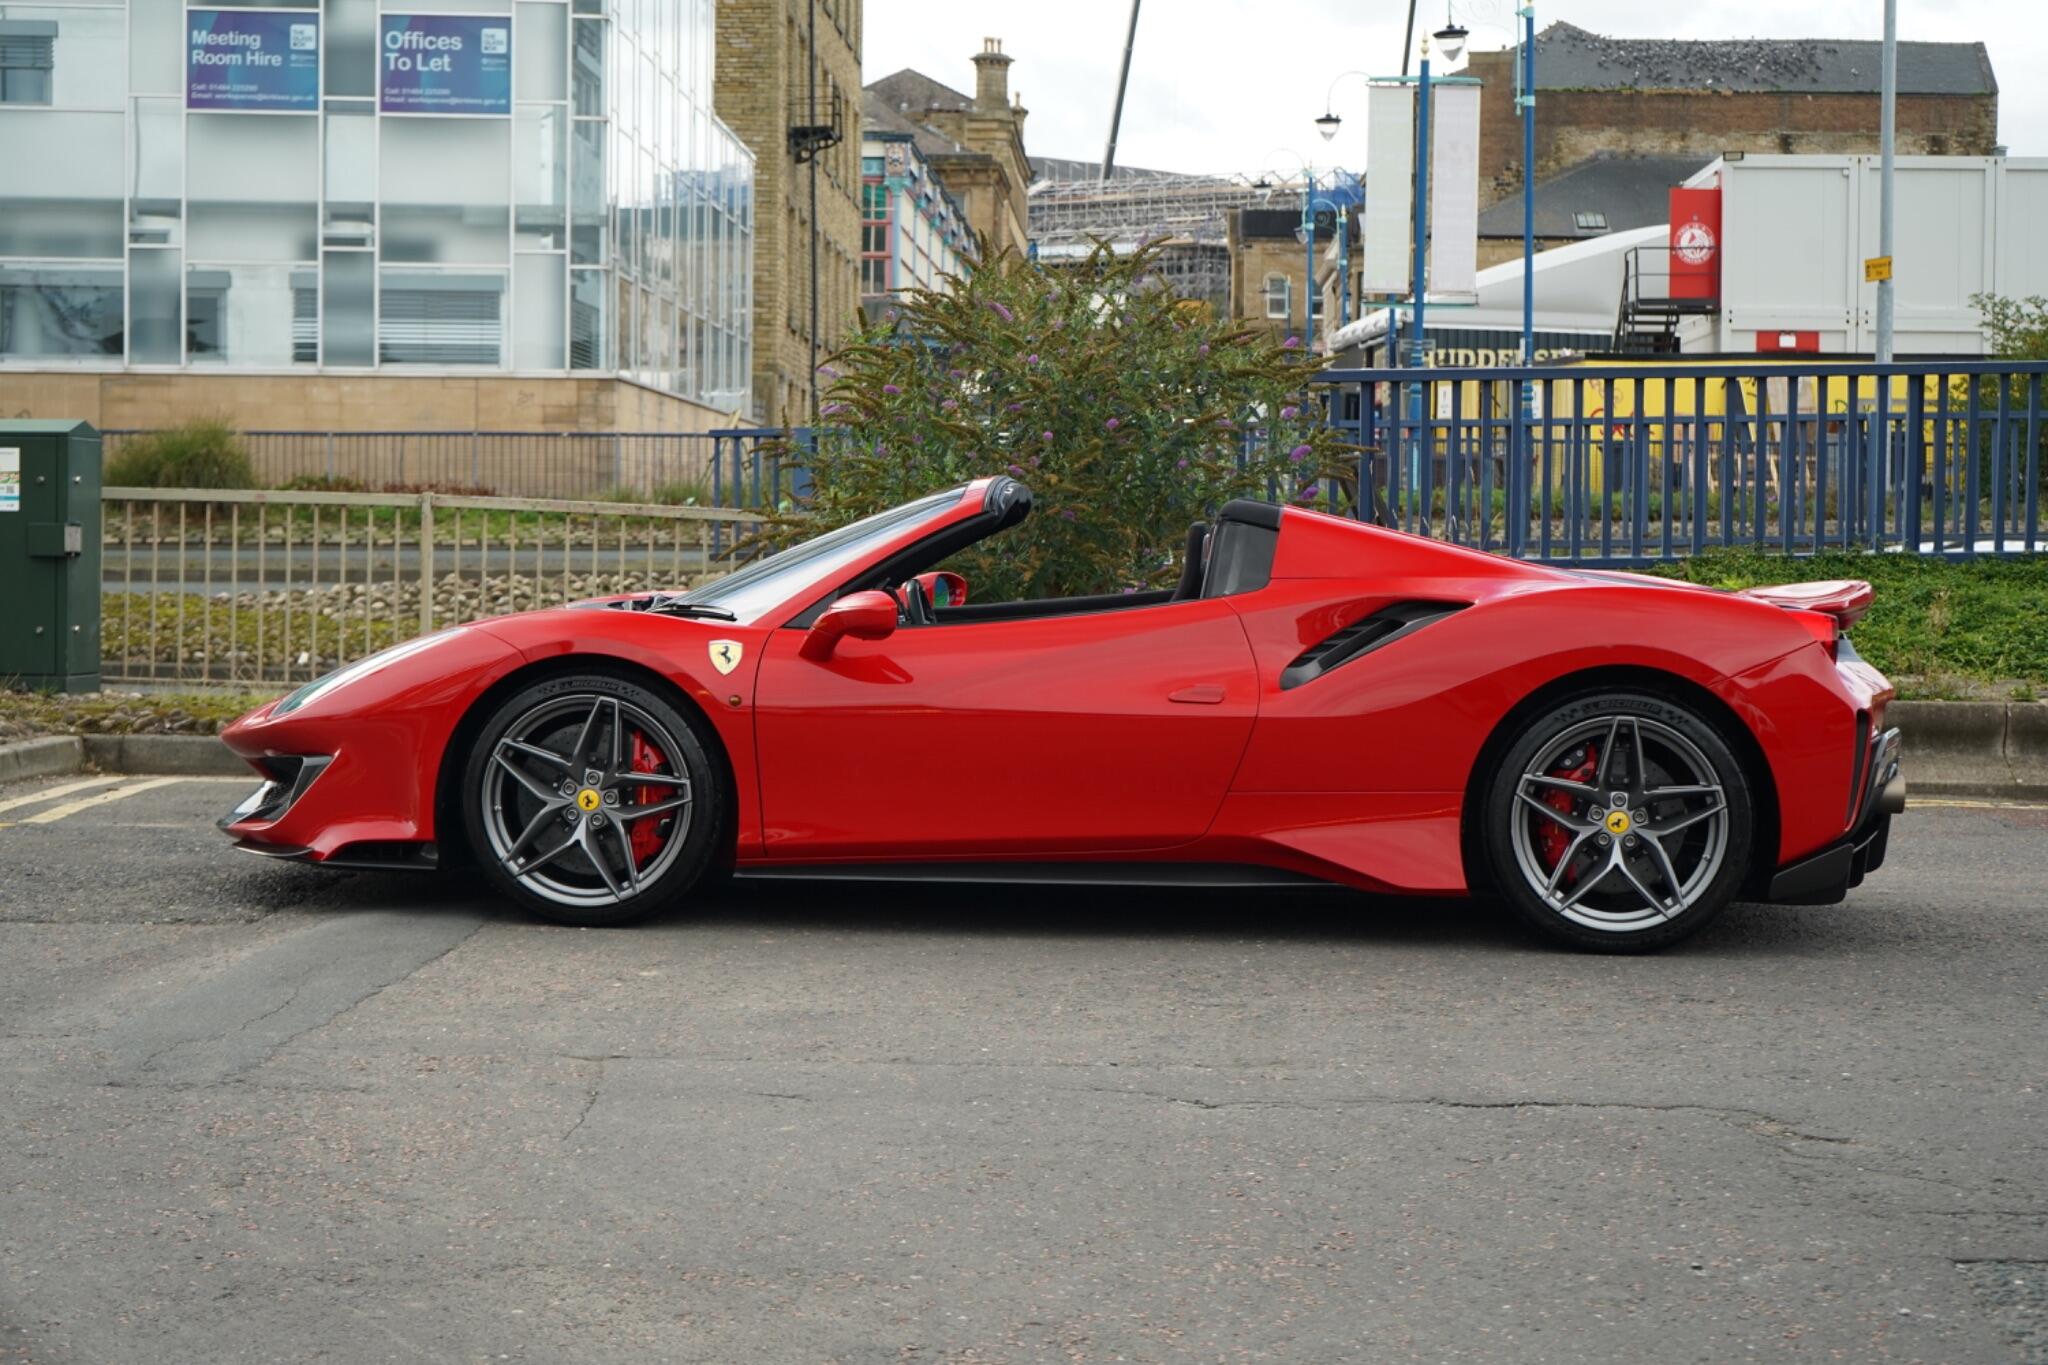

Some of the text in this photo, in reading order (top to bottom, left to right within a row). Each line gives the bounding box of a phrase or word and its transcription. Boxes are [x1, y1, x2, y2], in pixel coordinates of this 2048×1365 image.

[192, 30, 261, 50] Meeting
[385, 30, 463, 51] Offices
[192, 49, 242, 65] Room
[246, 51, 282, 67] Hire
[384, 53, 452, 72] To Let
